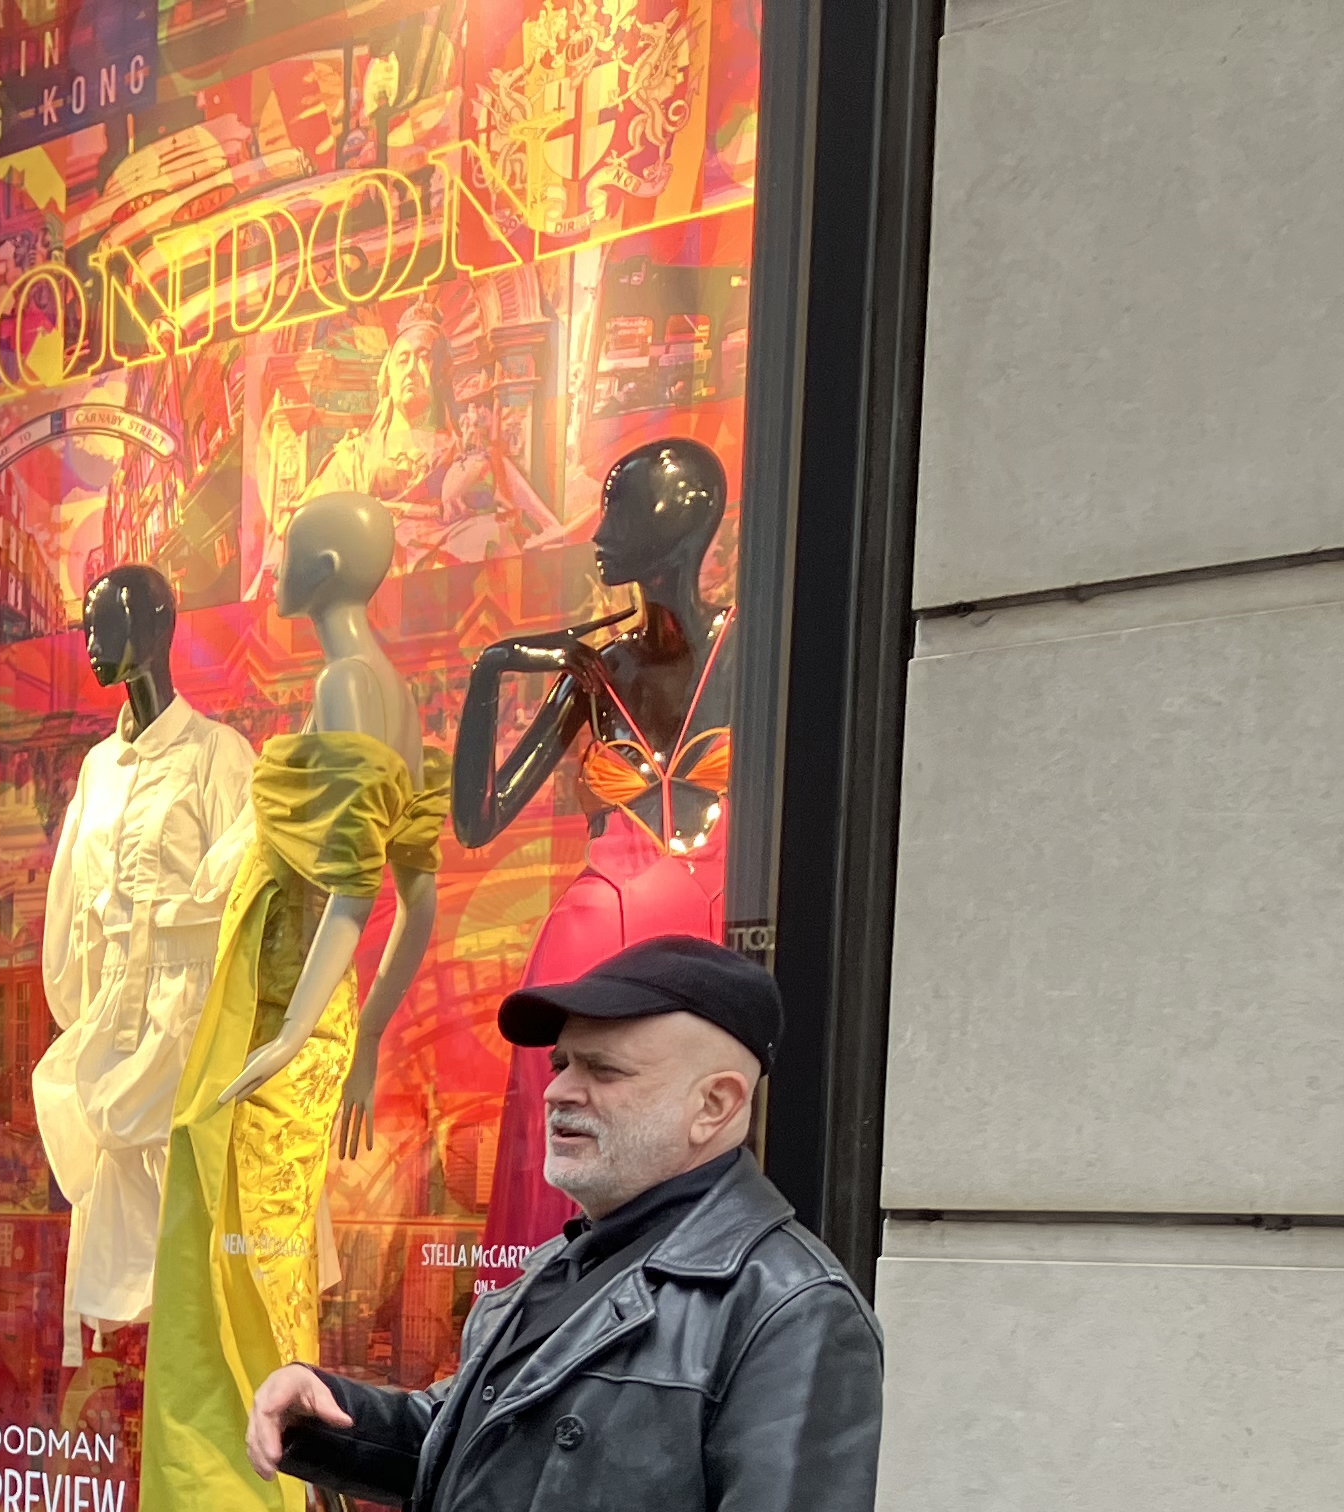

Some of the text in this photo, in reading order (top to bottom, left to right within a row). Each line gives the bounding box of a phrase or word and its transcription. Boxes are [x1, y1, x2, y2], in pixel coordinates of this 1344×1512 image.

[43, 55, 145, 126] KONG
[18, 430, 32, 445] TO
[75, 411, 167, 447] CARNABY STREET
[421, 1243, 538, 1269] STELLA McCART
[474, 1279, 497, 1296] ON 3
